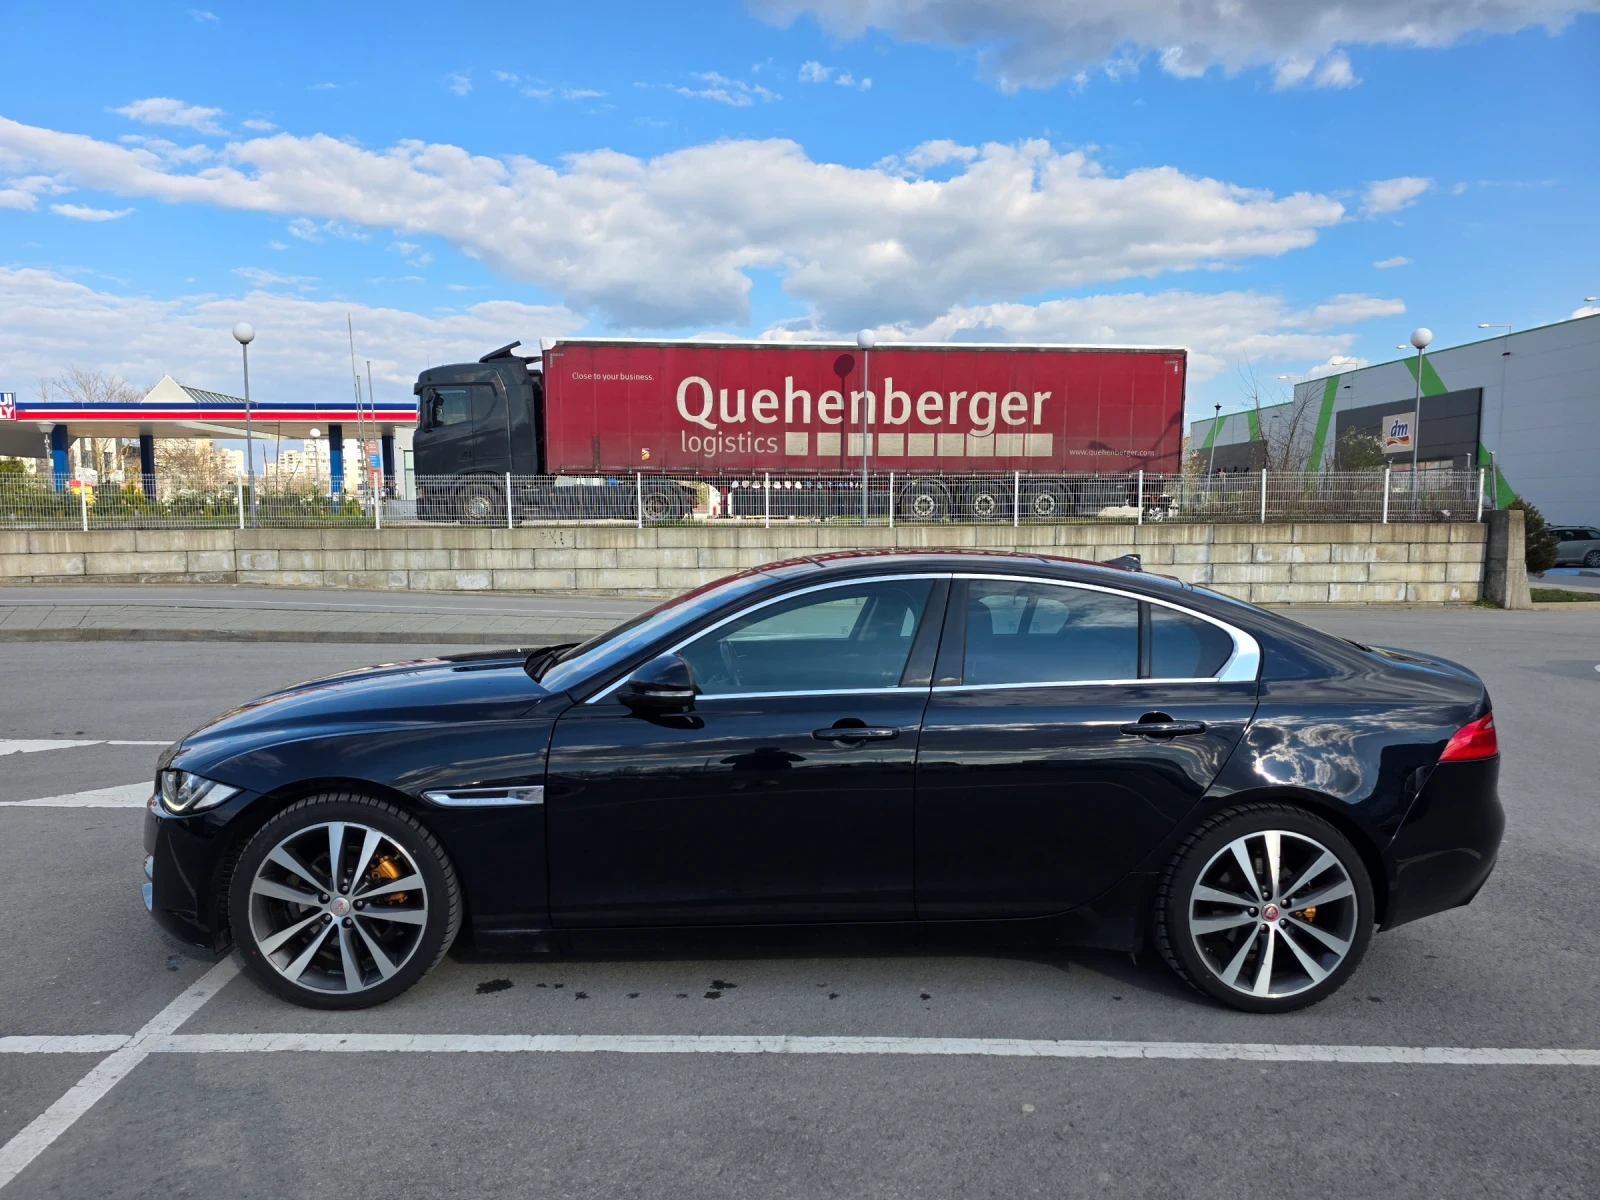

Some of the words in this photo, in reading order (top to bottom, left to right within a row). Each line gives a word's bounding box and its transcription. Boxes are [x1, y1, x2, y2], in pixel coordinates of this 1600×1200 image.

[571, 371, 592, 380] Close
[602, 373, 619, 381] your
[620, 373, 655, 381] business.
[676, 375, 1052, 437] Quehenberger
[1390, 420, 1408, 437] dm
[681, 430, 778, 458] logistics
[1069, 448, 1155, 457] www.quehenberger.com
